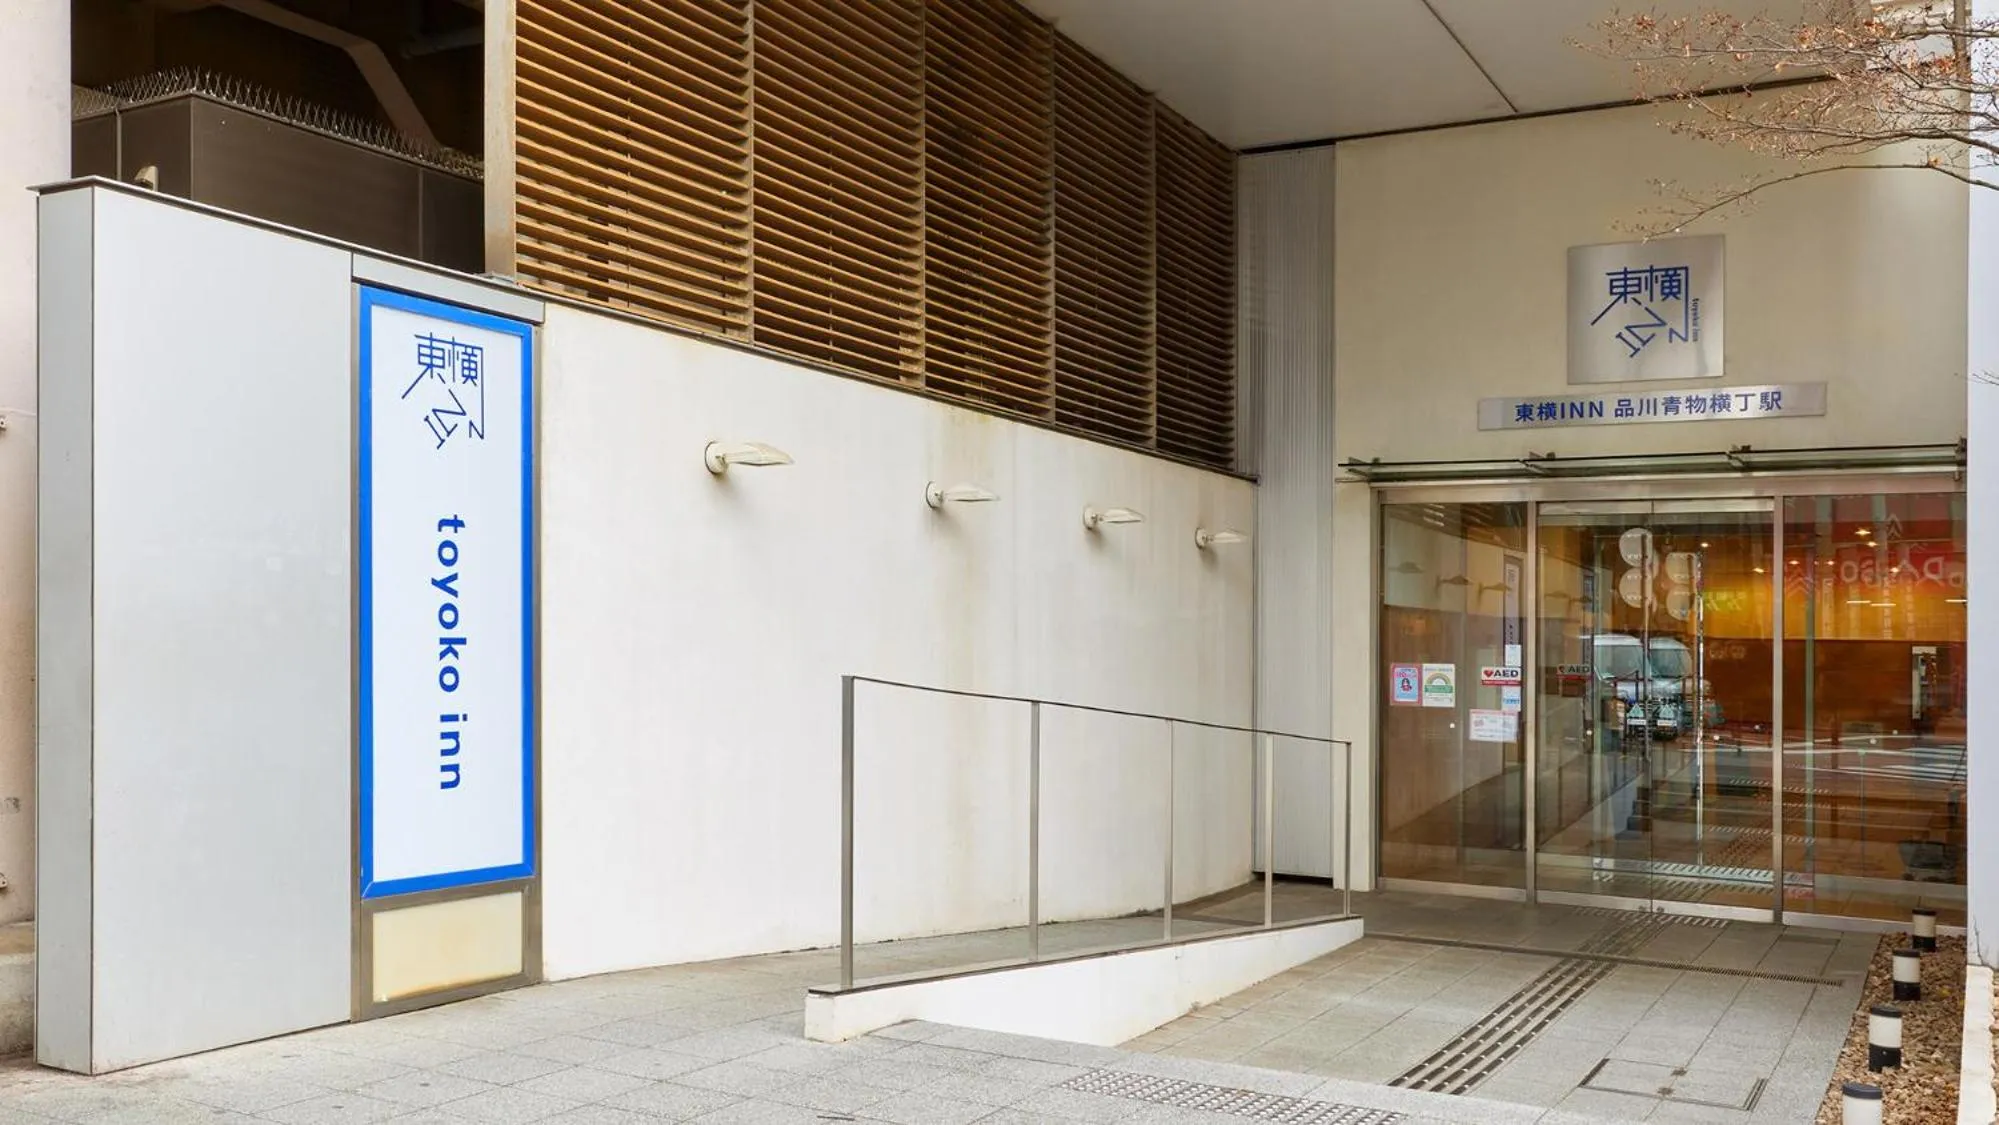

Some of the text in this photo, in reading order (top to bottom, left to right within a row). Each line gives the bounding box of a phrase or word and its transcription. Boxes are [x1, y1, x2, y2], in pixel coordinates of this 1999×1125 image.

[1515, 391, 1782, 423] 東横INN 品川青物横丁駅
[431, 514, 468, 789] toyoko inn
[1493, 668, 1519, 678] AED
[1568, 664, 1590, 674] AED
